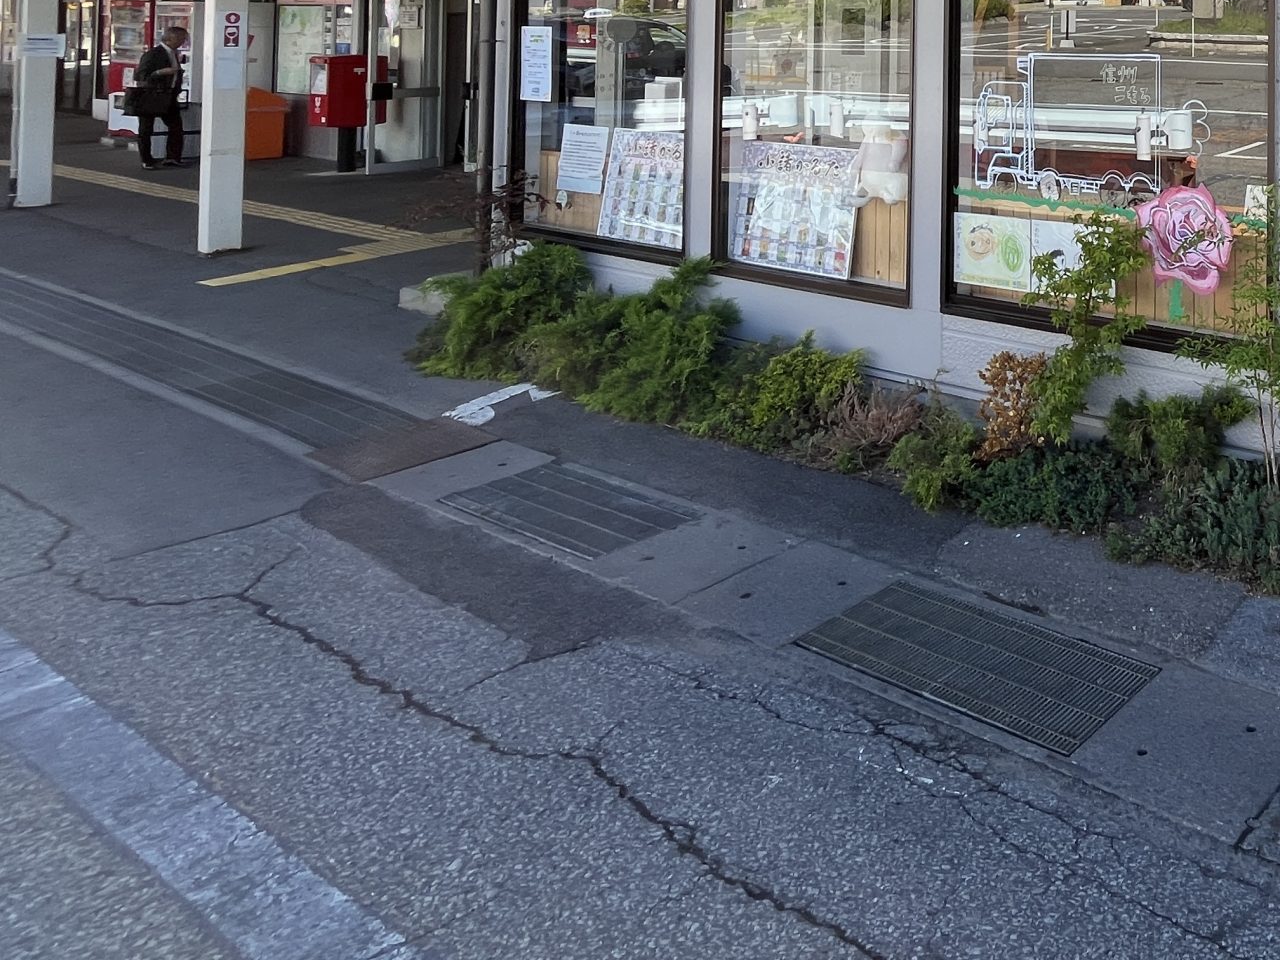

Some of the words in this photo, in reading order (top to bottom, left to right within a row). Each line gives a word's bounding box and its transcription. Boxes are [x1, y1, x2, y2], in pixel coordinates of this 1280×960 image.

[1100, 63, 1138, 84] 信州
[1114, 85, 1151, 105] こもろ
[757, 151, 841, 178] 小諸かるた
